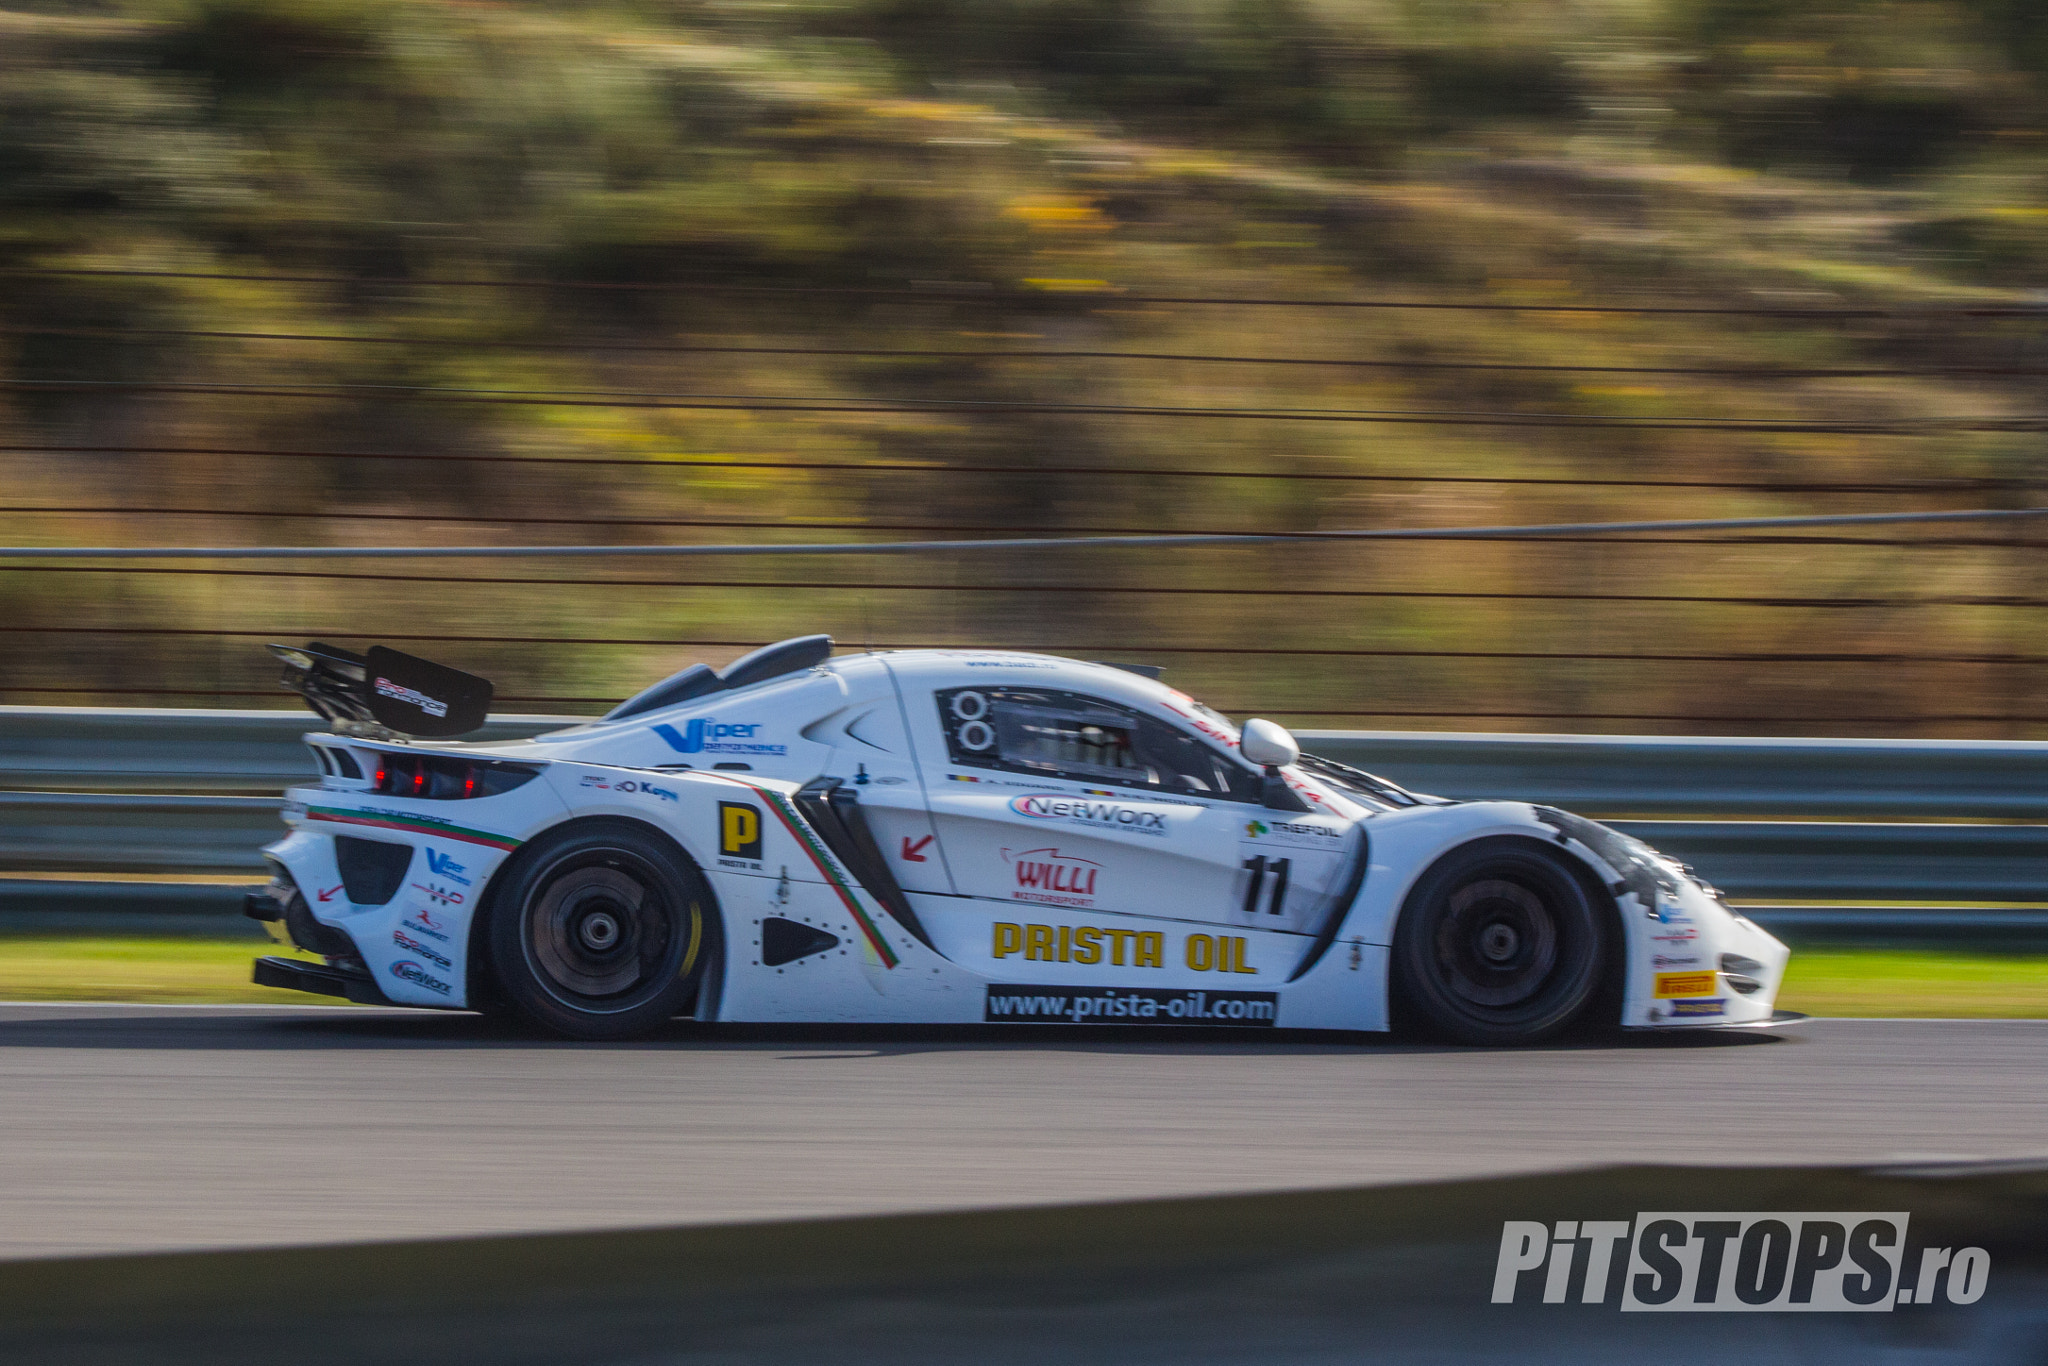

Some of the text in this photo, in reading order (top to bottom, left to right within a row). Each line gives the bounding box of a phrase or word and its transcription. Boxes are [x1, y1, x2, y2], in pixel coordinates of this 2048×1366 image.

[650, 718, 762, 753] Viper
[723, 806, 758, 852] P
[1026, 798, 1168, 830] NetWorx
[1269, 821, 1342, 838] TREFOIL
[1016, 861, 1098, 895] WILLI
[1243, 854, 1292, 916] 11
[1011, 891, 1094, 907] MOTORSPORT
[992, 921, 1258, 975] PRISTA OIL
[988, 990, 1274, 1022] www.prista-oil.com
